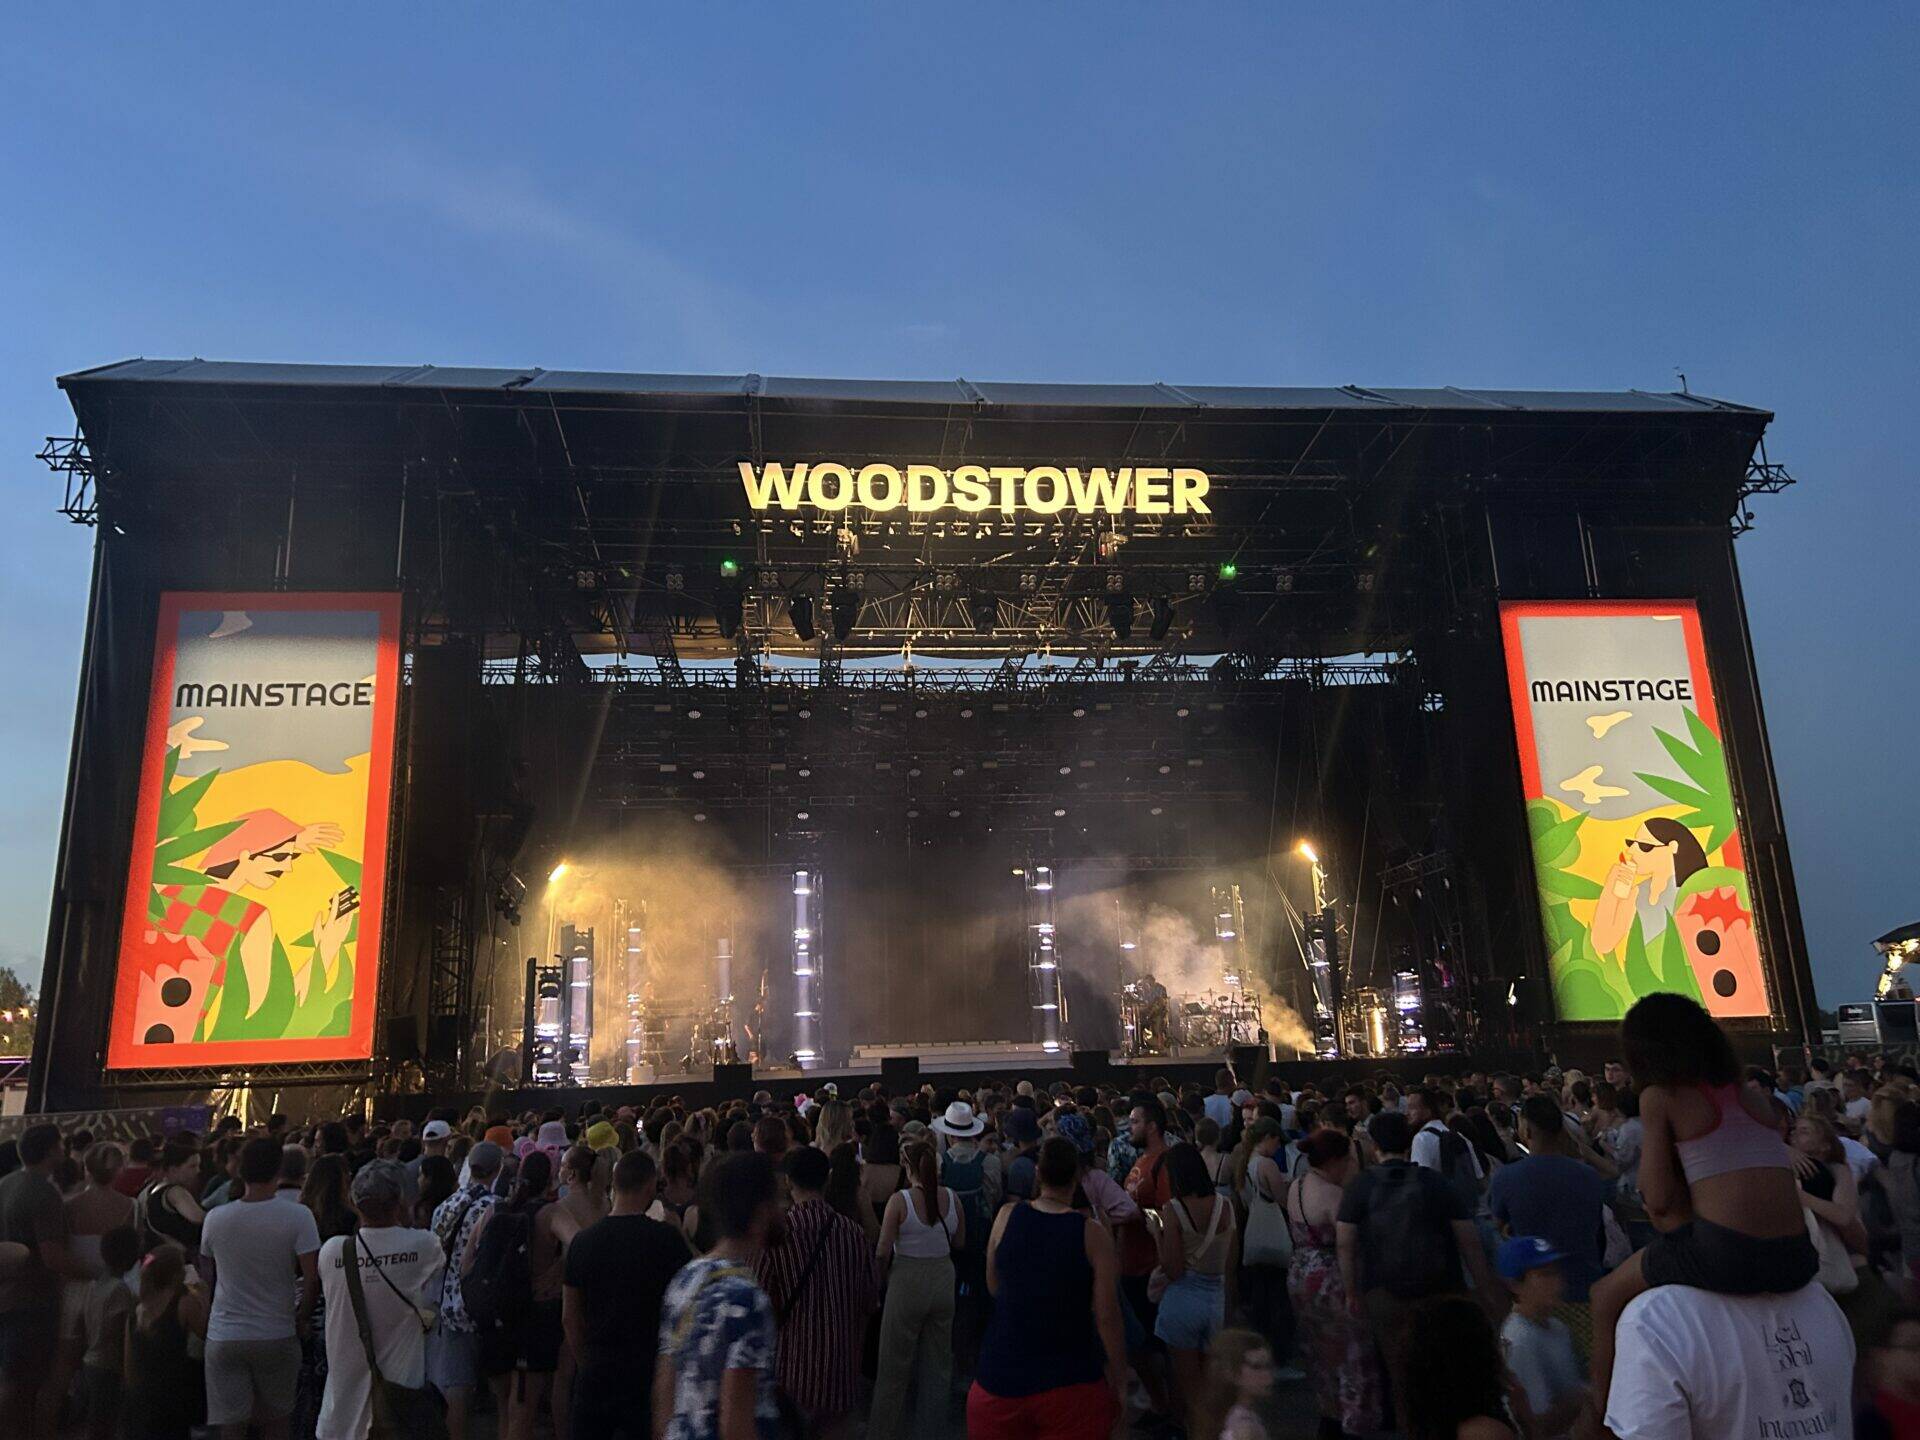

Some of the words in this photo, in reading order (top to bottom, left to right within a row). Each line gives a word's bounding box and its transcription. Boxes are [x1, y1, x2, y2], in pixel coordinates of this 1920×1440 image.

[738, 462, 1212, 514] WOODSTOWER
[176, 682, 372, 707] MAINSTAGE
[1531, 679, 1692, 702] MAINSTAGE
[334, 1251, 419, 1269] WODSTEAM
